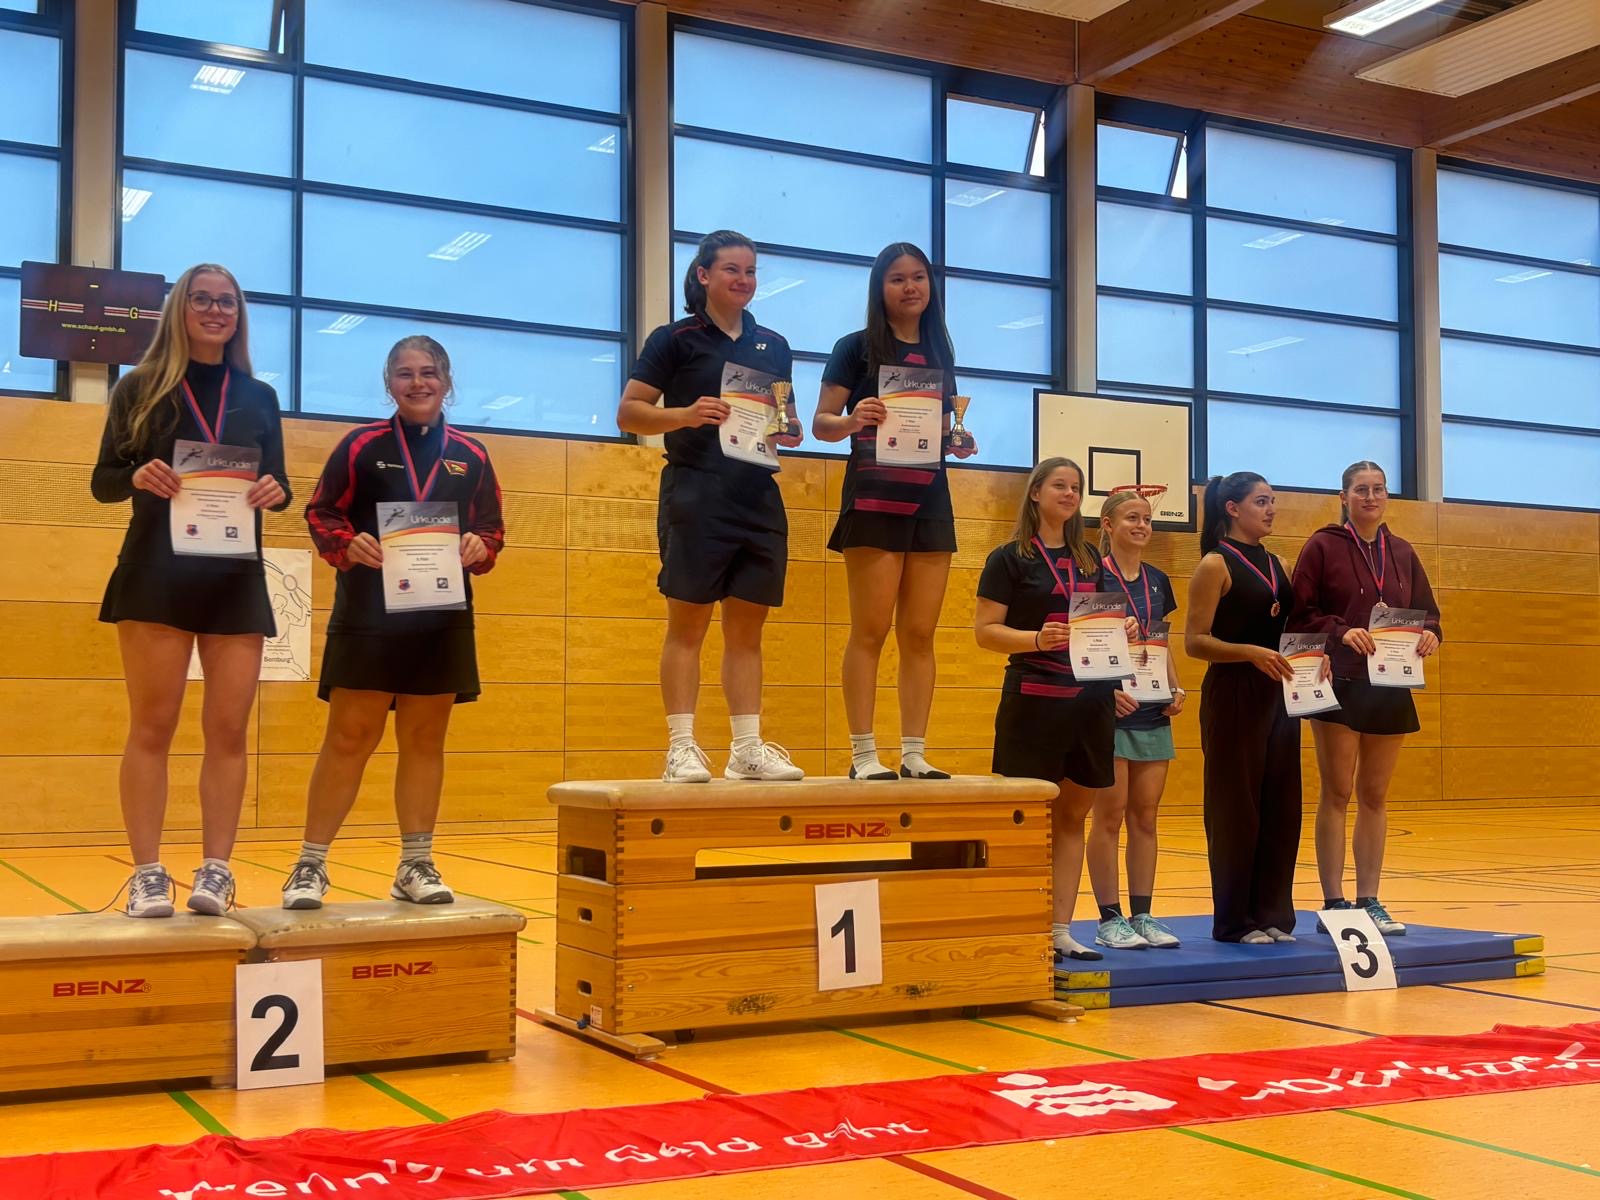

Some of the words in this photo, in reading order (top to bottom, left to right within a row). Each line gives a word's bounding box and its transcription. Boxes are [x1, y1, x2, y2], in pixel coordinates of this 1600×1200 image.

[48, 300, 58, 312] H
[129, 307, 139, 319] G
[903, 379, 937, 390] Urkunde
[410, 514, 451, 525] Urkunde
[830, 908, 857, 974] 1
[1340, 927, 1379, 979] 3
[249, 994, 300, 1072] 2
